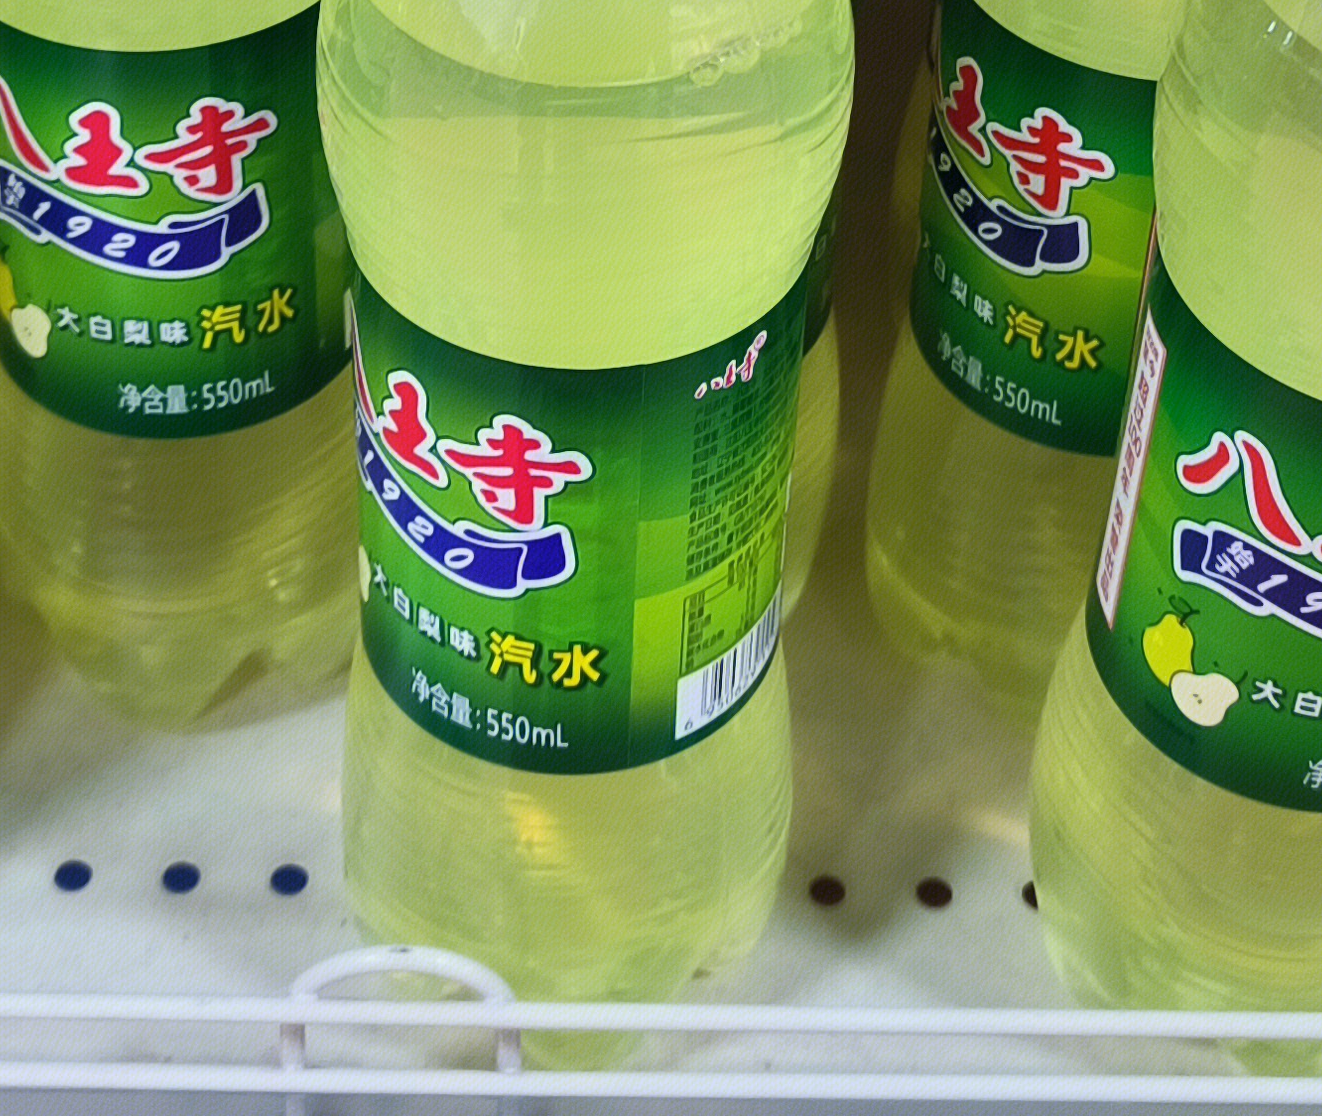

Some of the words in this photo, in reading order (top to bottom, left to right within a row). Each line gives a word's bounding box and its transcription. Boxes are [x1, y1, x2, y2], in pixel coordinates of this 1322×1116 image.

[200, 287, 295, 350] 汽水
[1004, 304, 1101, 372] 汽水
[488, 631, 602, 687] 汽水
[412, 667, 569, 749] 净含量:550mL
